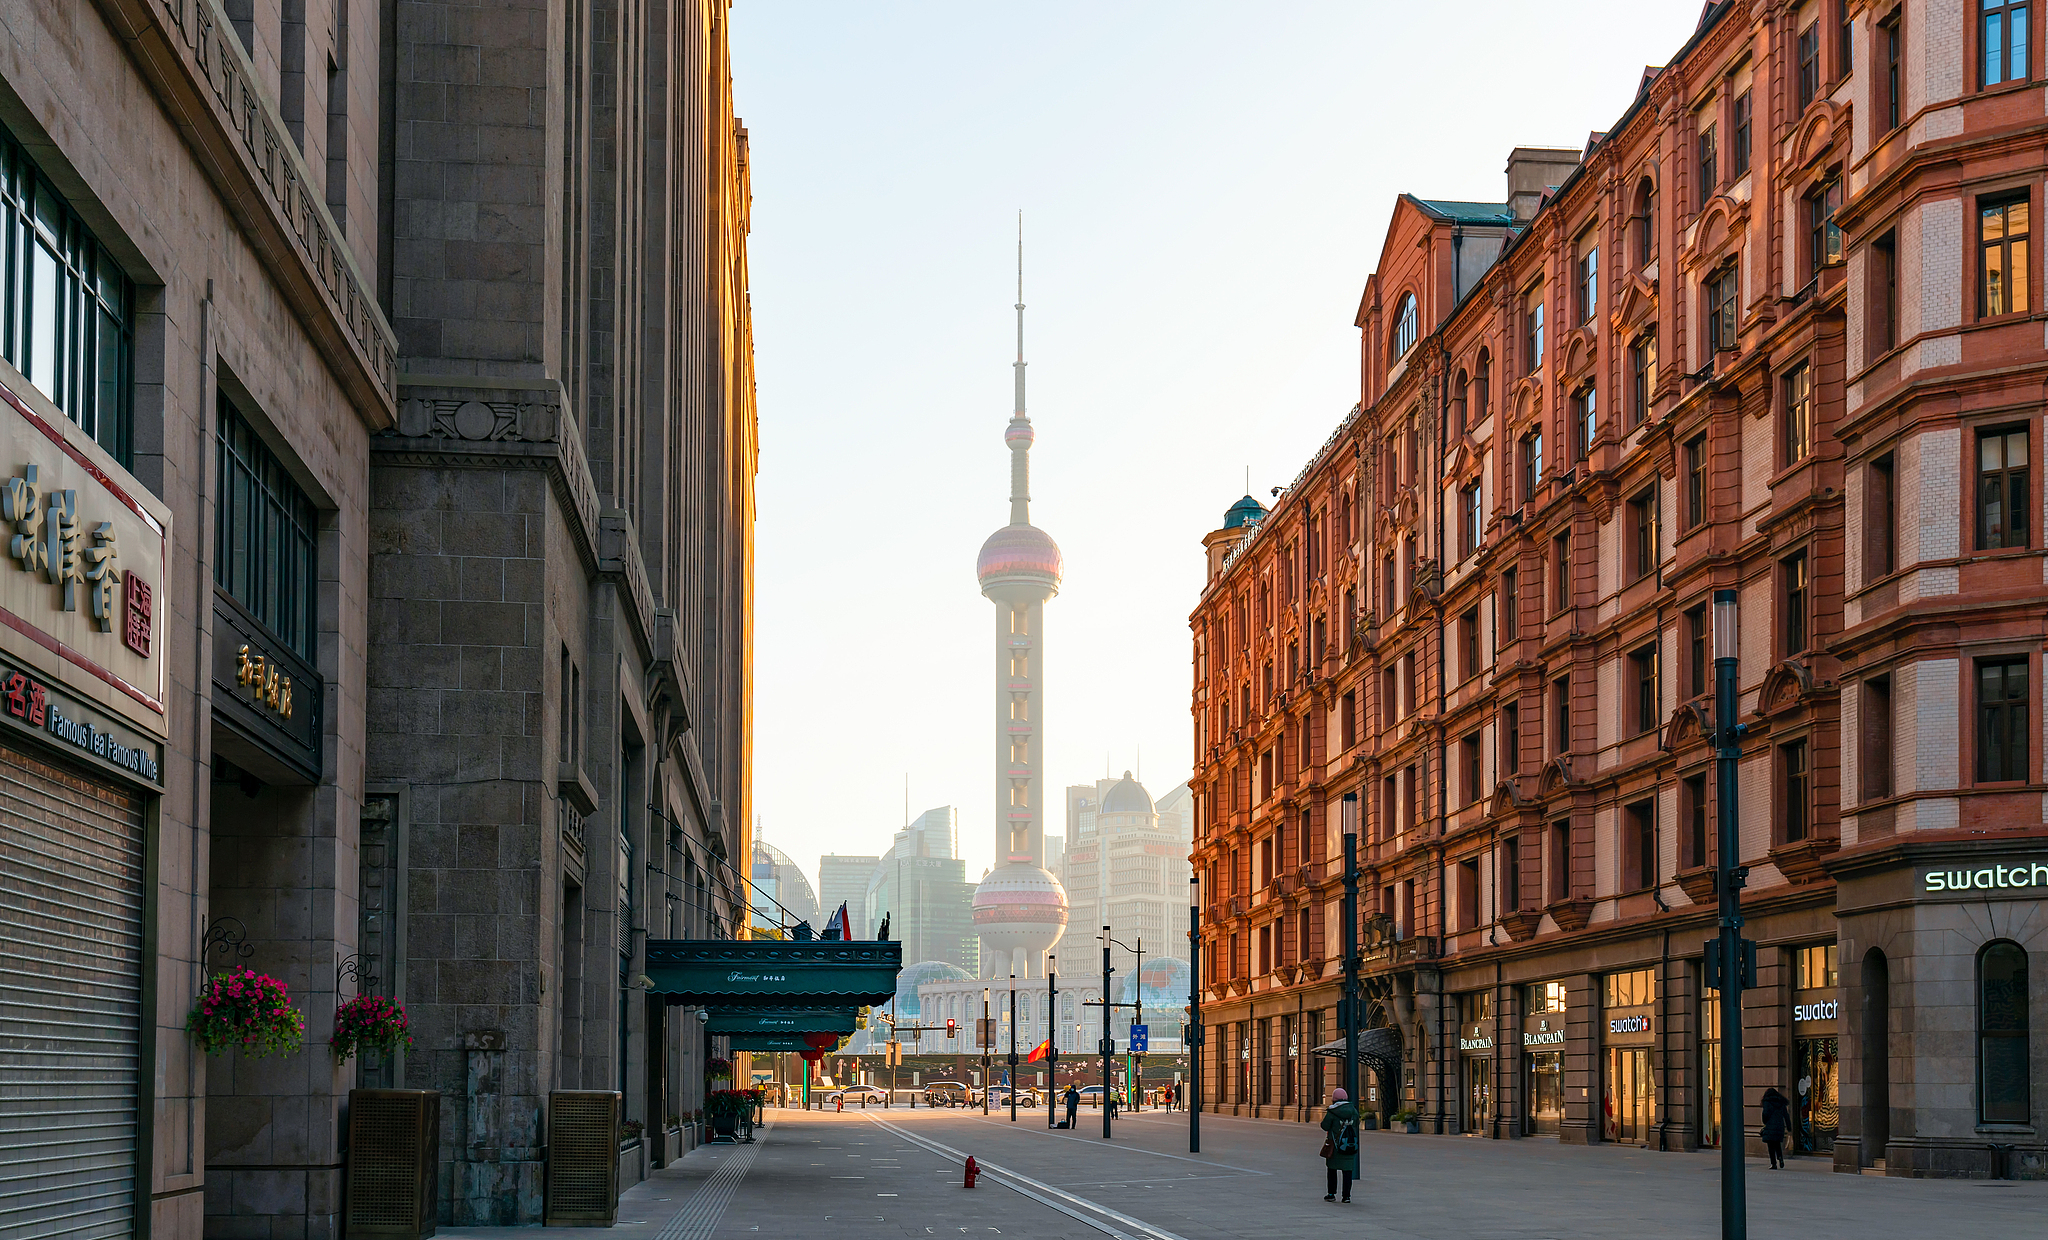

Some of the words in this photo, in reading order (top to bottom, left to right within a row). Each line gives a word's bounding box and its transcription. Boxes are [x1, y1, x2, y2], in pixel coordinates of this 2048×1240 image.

[6, 670, 46, 726] 名酒
[50, 704, 88, 748] Famous
[89, 723, 105, 756] Tea
[108, 733, 138, 772] Famous
[140, 749, 158, 780] Wine
[1925, 863, 2048, 891] swatch
[1610, 1014, 1643, 1033] swatch
[1460, 1036, 1493, 1049] BLANCPAIN
[1523, 1030, 1564, 1046] BLANCPAIN
